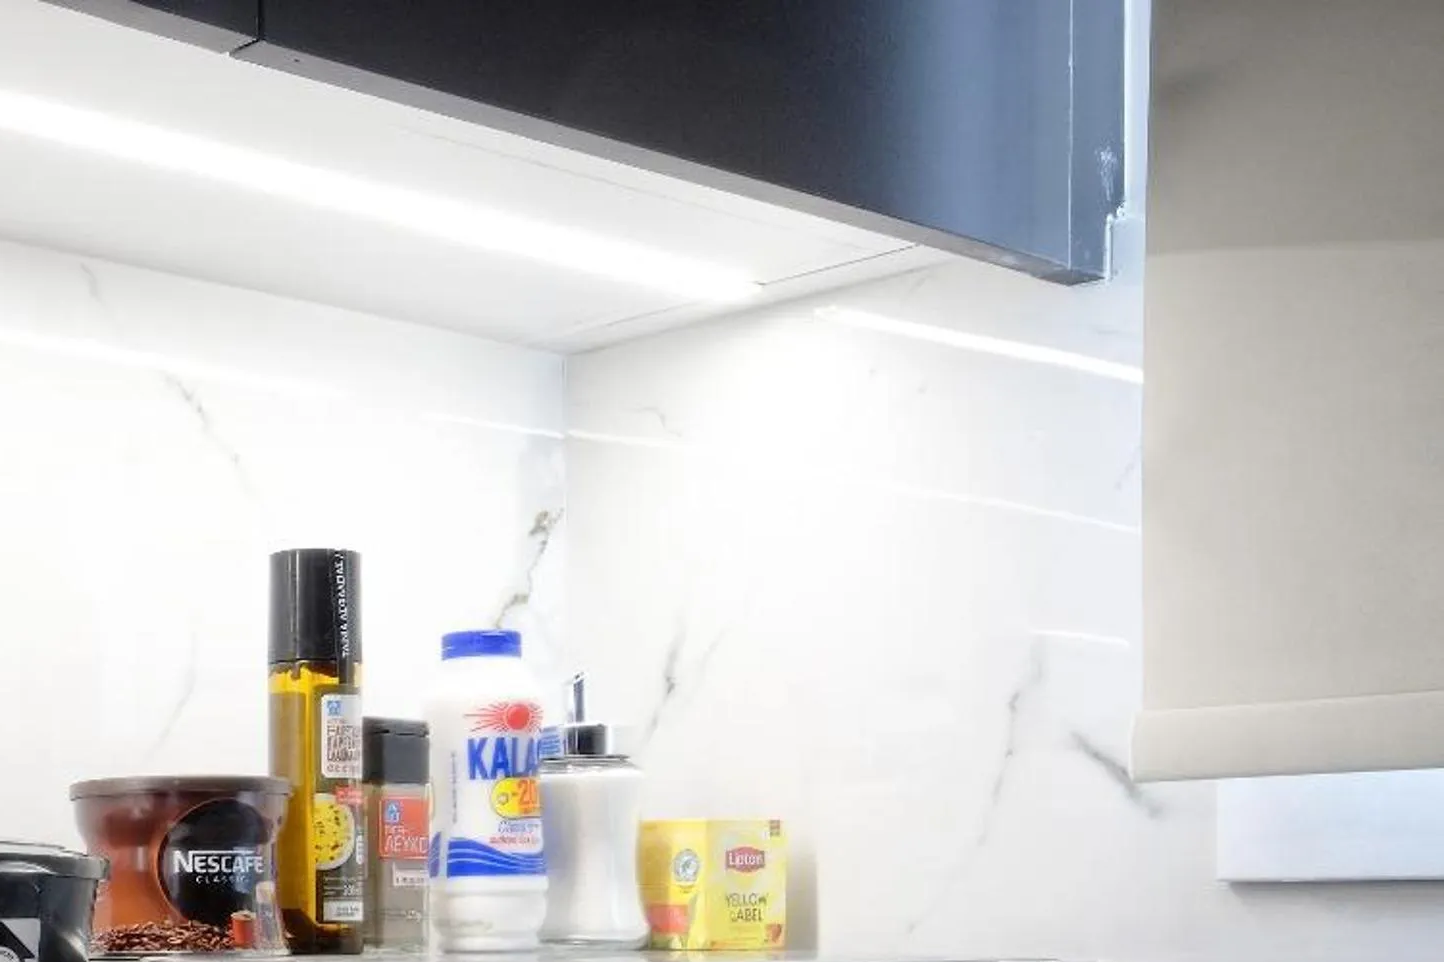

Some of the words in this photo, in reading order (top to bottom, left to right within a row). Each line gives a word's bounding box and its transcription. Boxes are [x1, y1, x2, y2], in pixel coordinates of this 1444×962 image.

[468, 737, 539, 780] KALA
[728, 851, 764, 866] Lipton
[726, 893, 768, 907] YELLOW
